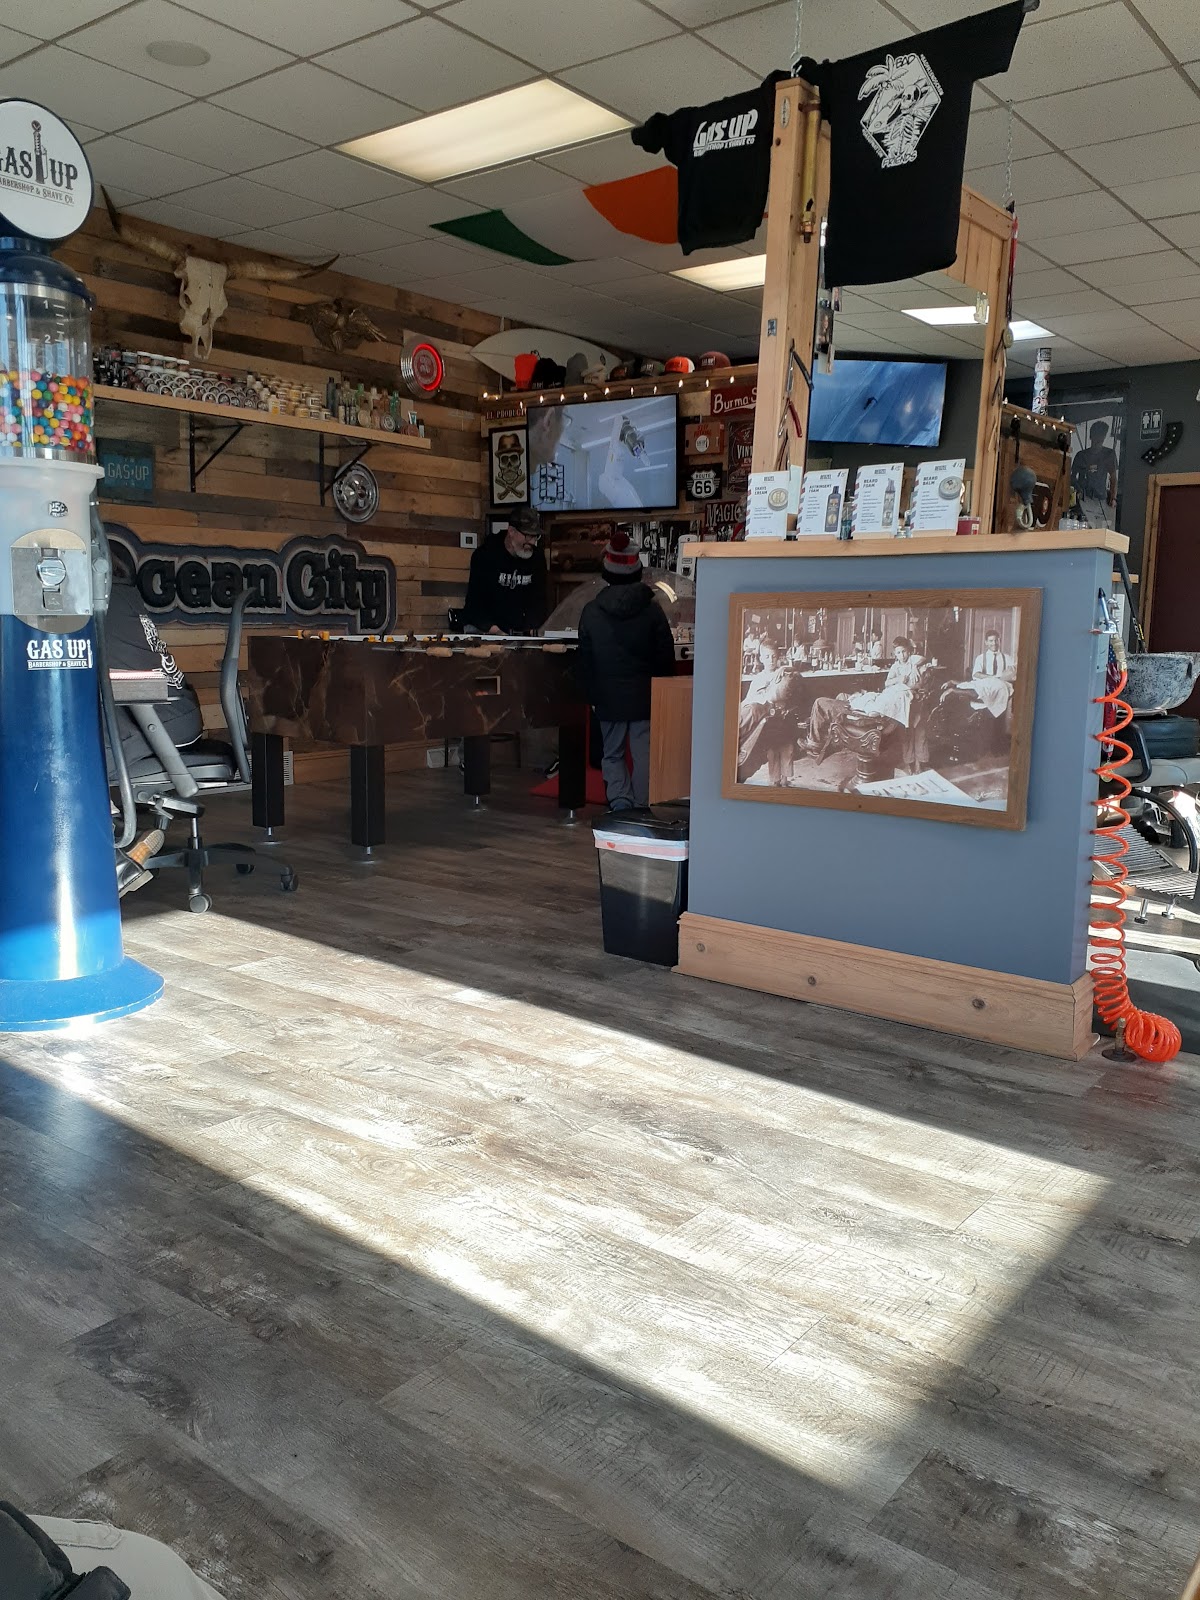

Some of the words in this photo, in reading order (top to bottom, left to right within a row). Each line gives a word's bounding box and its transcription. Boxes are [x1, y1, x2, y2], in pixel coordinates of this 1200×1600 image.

[895, 56, 916, 69] BAD
[728, 109, 758, 138] UP
[881, 149, 918, 168] FRIENDS
[49, 158, 78, 190] UP
[35, 187, 41, 195] &
[42, 188, 63, 201] SHAVE
[43, 300, 49, 310] 1
[44, 334, 51, 344] 2
[108, 462, 130, 480] GAS
[135, 465, 149, 480] UP
[695, 480, 712, 494] 66
[286, 548, 387, 630] City
[26, 639, 64, 660] GAS
[66, 638, 87, 659] UP
[27, 661, 62, 669] BARBERSHOP
